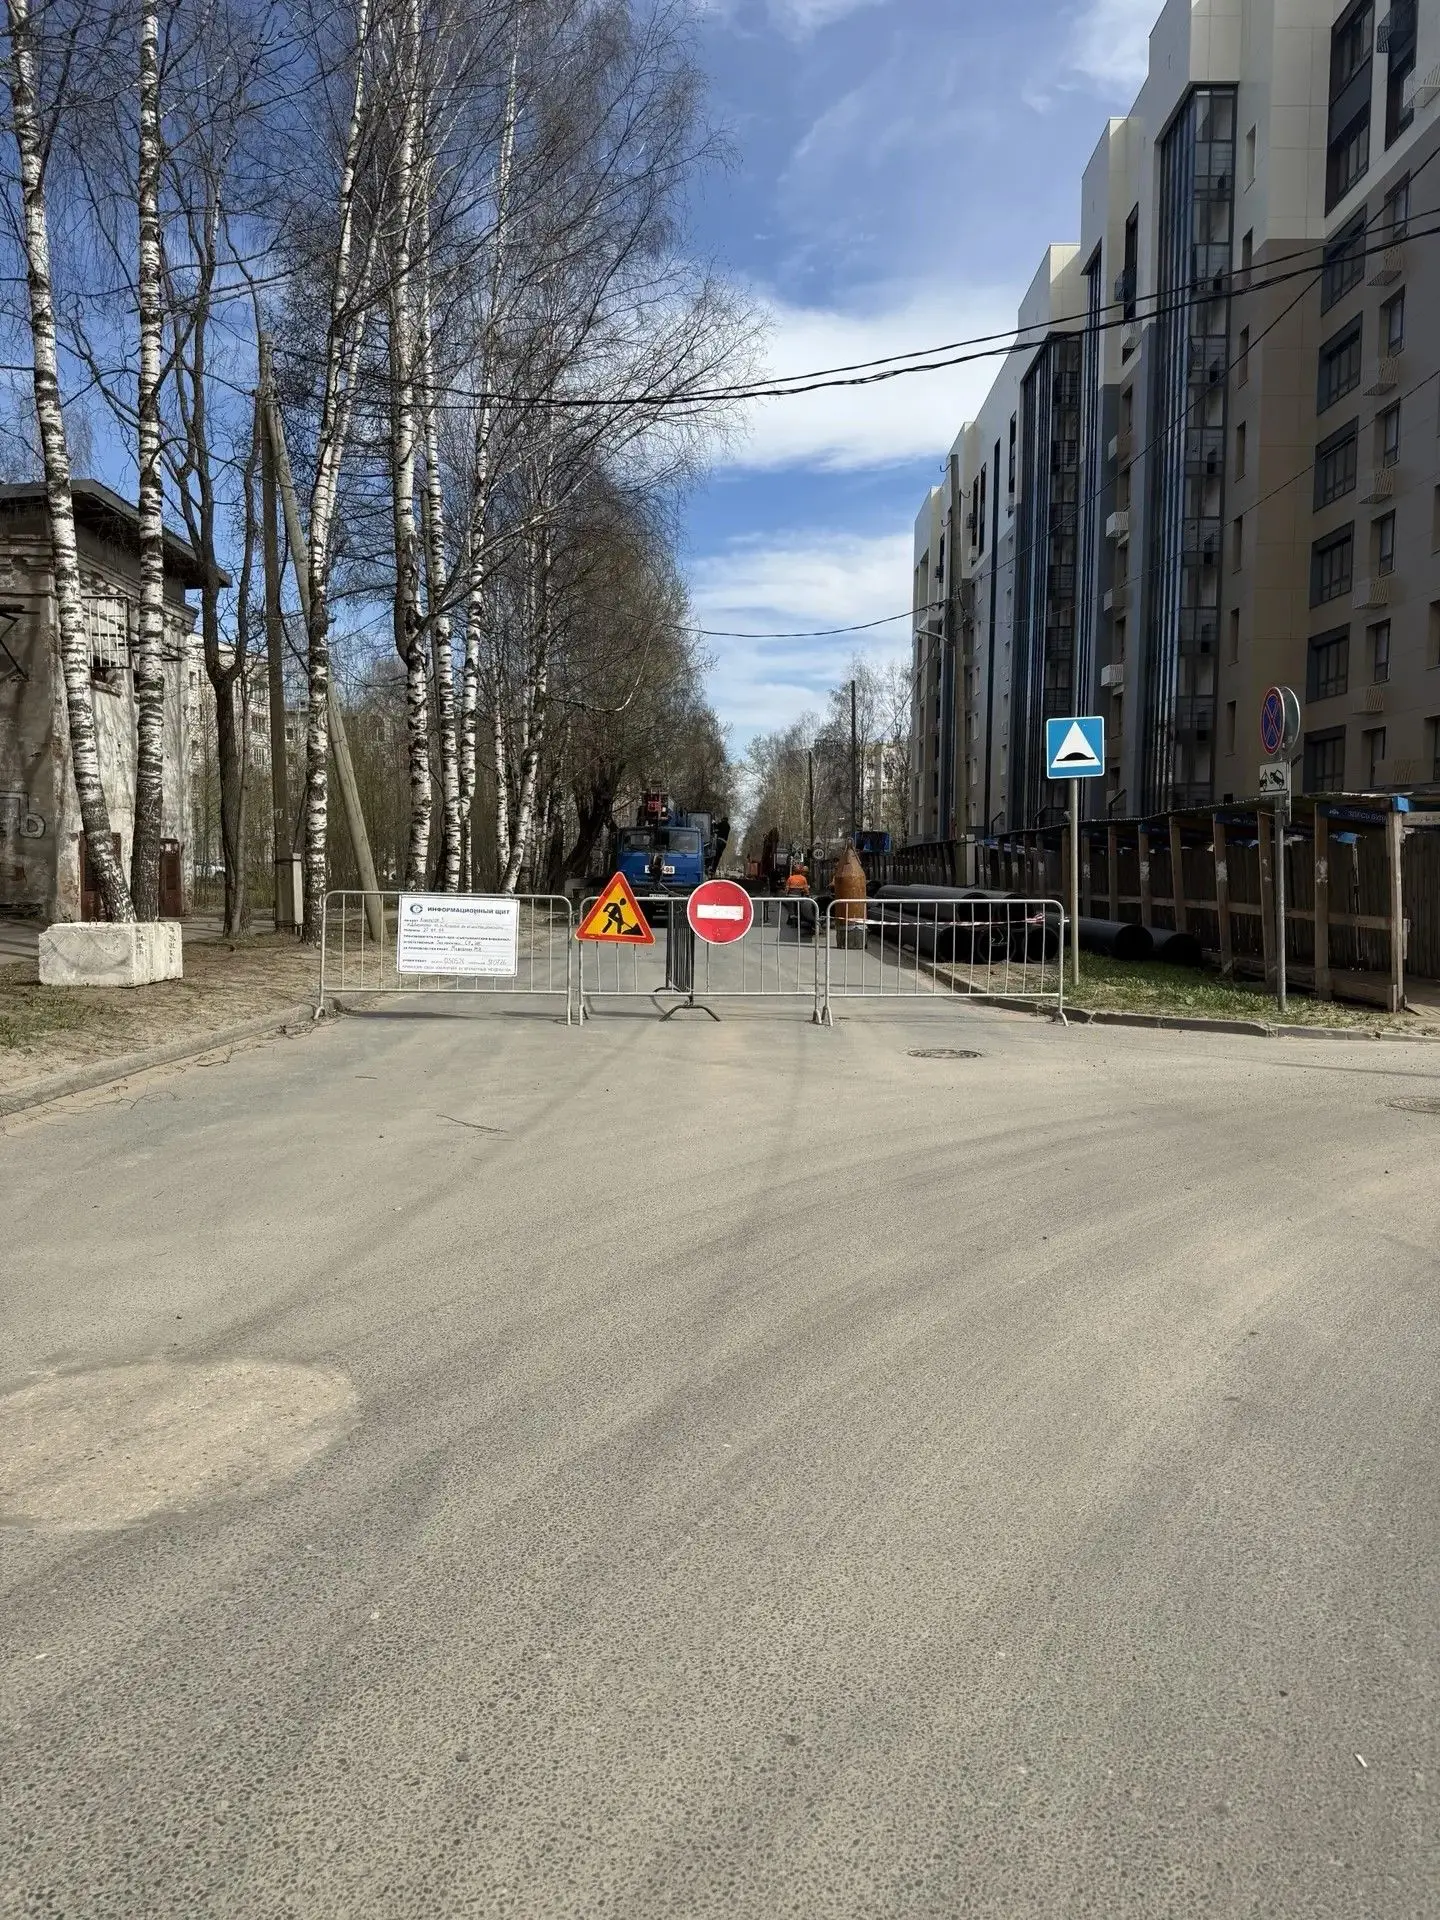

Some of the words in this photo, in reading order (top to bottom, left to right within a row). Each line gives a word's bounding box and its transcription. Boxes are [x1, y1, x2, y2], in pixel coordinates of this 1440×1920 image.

[814, 850, 823, 858] 40
[427, 906, 493, 915] ИНФОРМАЦИОННЫЙ
[495, 908, 510, 916] ЩИТ
